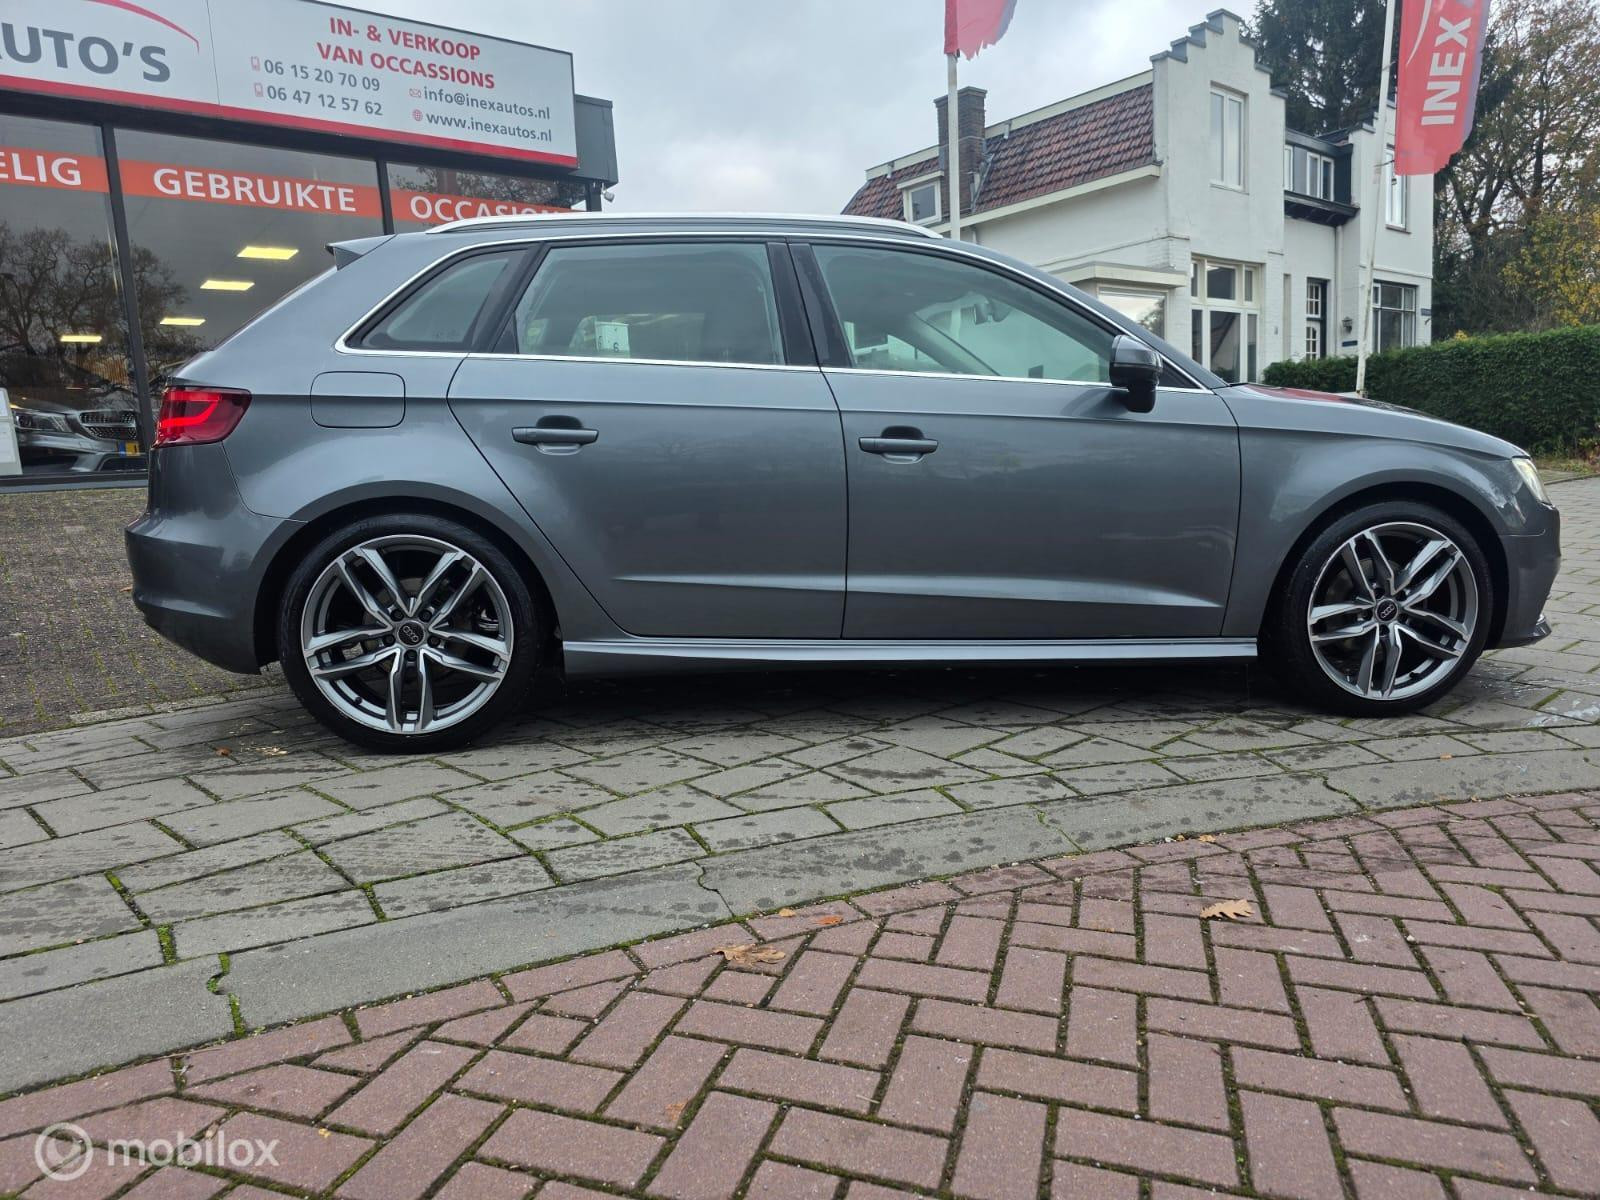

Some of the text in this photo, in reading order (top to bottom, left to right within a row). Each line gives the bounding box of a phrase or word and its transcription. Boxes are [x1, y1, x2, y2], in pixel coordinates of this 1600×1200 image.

[0, 22, 171, 83] UTO'S
[330, 17, 481, 61] IN- & VERKOOP
[264, 59, 380, 91] 06 15 20 70 09
[317, 42, 495, 89] VAN OCCASSIONS
[1421, 16, 1472, 126] INEX
[267, 85, 383, 116] 06 47 12 57 62
[423, 86, 551, 120] info@inexautos.nl
[426, 113, 552, 142] www.inexautos.nl
[153, 168, 356, 212] GEBRUIKTE
